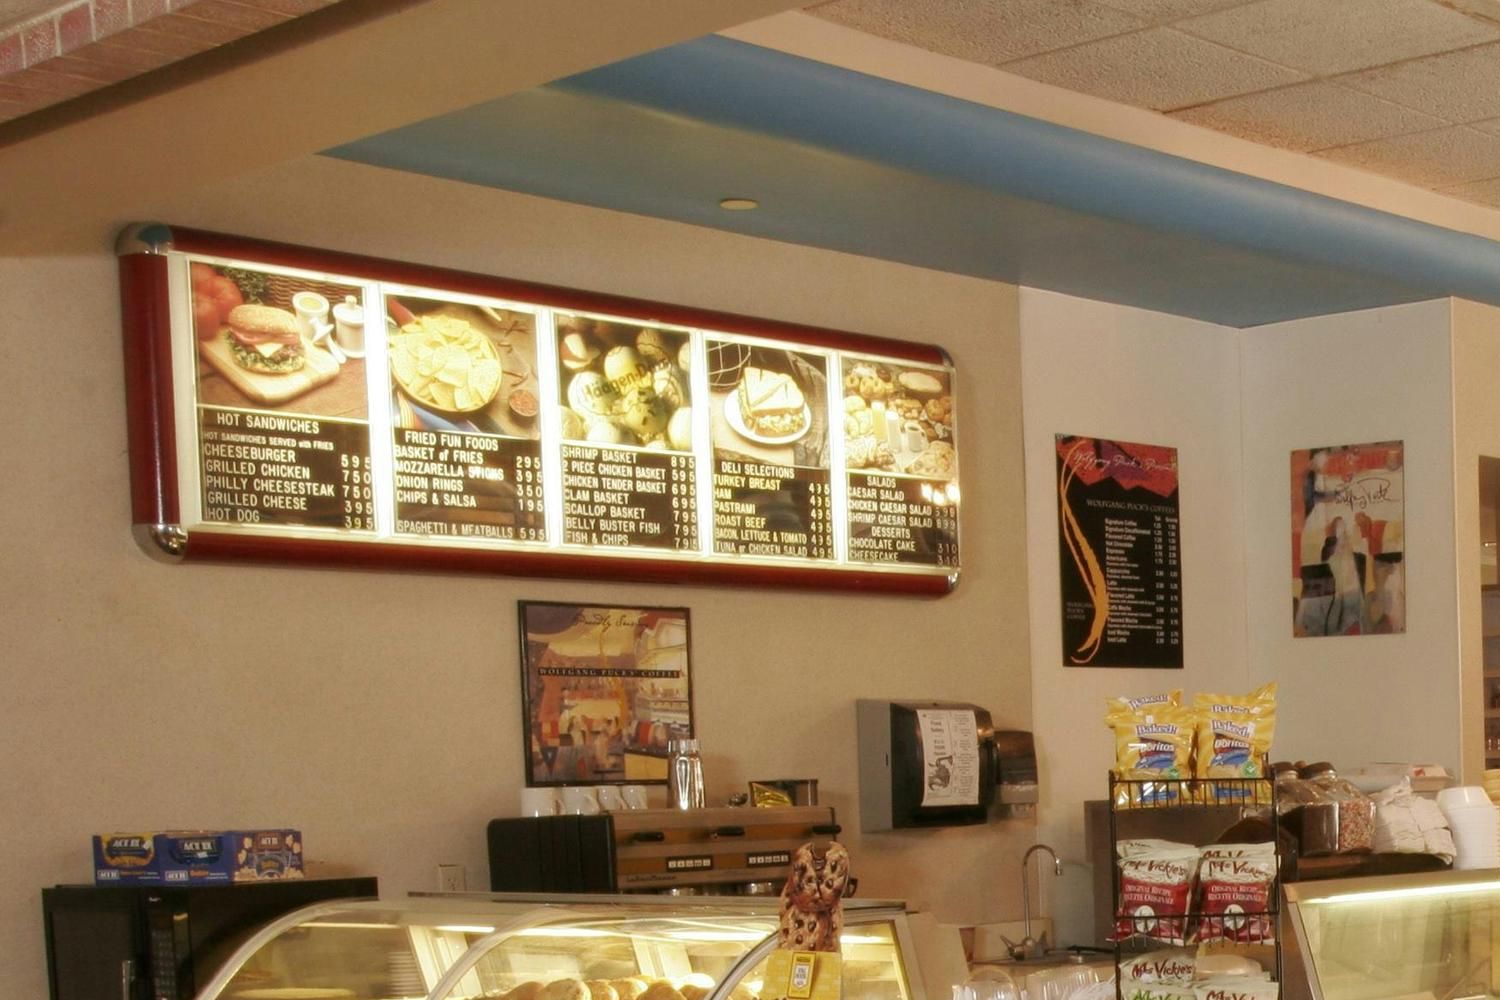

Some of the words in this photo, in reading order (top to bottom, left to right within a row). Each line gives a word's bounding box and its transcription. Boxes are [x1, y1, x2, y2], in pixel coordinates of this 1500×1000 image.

[217, 412, 240, 426] HOT
[246, 416, 320, 434] SANDWICHES
[222, 433, 267, 444] SANDWICHES
[269, 438, 296, 447] SERVED
[313, 442, 334, 450] FRIES
[405, 431, 436, 445] FRIED
[441, 434, 461, 448] FUN
[466, 437, 498, 450] FOODS
[205, 443, 296, 462] CHEESEBURGER
[341, 455, 371, 469] 595
[395, 445, 434, 460] BASKET
[439, 450, 449, 461] of
[453, 450, 483, 464] FRIES
[516, 456, 541, 469] 295
[563, 447, 598, 460] SHRIMP
[602, 450, 637, 464] BASKET
[206, 460, 255, 475] GRILLED
[261, 464, 310, 479] CHICKEN
[342, 470, 371, 483] 750
[395, 461, 464, 477] MOZZARELLA
[516, 470, 542, 483] 395
[572, 461, 595, 473] PIECE
[598, 464, 633, 478] CHICKEN
[636, 467, 666, 480] BASKET
[721, 461, 741, 473] DELI
[745, 465, 795, 479] SELECTIONS
[206, 476, 247, 490] PHILLY
[253, 481, 335, 497] CHEESESTEAK
[342, 486, 371, 499] 750
[396, 476, 428, 489] ONION
[433, 479, 463, 492] RINGS
[517, 485, 542, 497] 350
[563, 475, 598, 488] CHICKEN
[602, 479, 633, 491] TENDER
[636, 481, 667, 493] BASKET
[713, 474, 745, 488] TURKEY
[749, 478, 781, 490] BREAST
[867, 476, 896, 488] SALADS
[396, 491, 427, 504] CHIPS
[432, 493, 439, 505] &
[443, 494, 477, 507] SALSA
[518, 499, 543, 512] 195
[564, 490, 590, 501] CLAM
[594, 492, 629, 504] BASKET
[714, 488, 732, 499] HAM
[849, 487, 877, 499] CAESAR
[880, 490, 904, 501] SALAD
[208, 491, 258, 506] GRILLED
[263, 495, 307, 510] CHEESE
[345, 501, 373, 514] 395
[714, 501, 755, 514] PASTRAMI
[849, 500, 877, 511] CHICKEN
[880, 502, 907, 514] CAESAR
[909, 504, 932, 516] SALAD
[207, 508, 230, 521] HOT
[237, 510, 260, 522] DOG
[345, 517, 373, 529] 395
[565, 504, 606, 516] SCALLOP
[610, 507, 645, 519] BASKET
[566, 518, 595, 530] BELLY
[600, 520, 635, 532] BUSTER
[639, 522, 660, 534] FISH
[715, 514, 741, 526] ROAST
[745, 517, 766, 528] BEEF
[848, 512, 875, 523] SHRIMP
[878, 514, 906, 526] CAESAR
[909, 517, 932, 528] SALAD
[397, 521, 447, 534] SPAGHETTI
[452, 524, 457, 535] &
[462, 524, 513, 538] MEATBALLS
[741, 530, 770, 542] LETTUCE
[781, 532, 807, 545] TOMATO
[872, 526, 910, 539] DESSERTS
[566, 531, 587, 543] FISH
[592, 533, 597, 544] &
[602, 533, 628, 546] CHIPS
[849, 537, 893, 550] CHOCOLATE
[896, 540, 916, 551] CAKE
[716, 541, 736, 552] TUNA
[749, 543, 780, 555] CHICKEN
[784, 546, 807, 557] SALAD
[849, 550, 898, 561] CHEESECAKE
